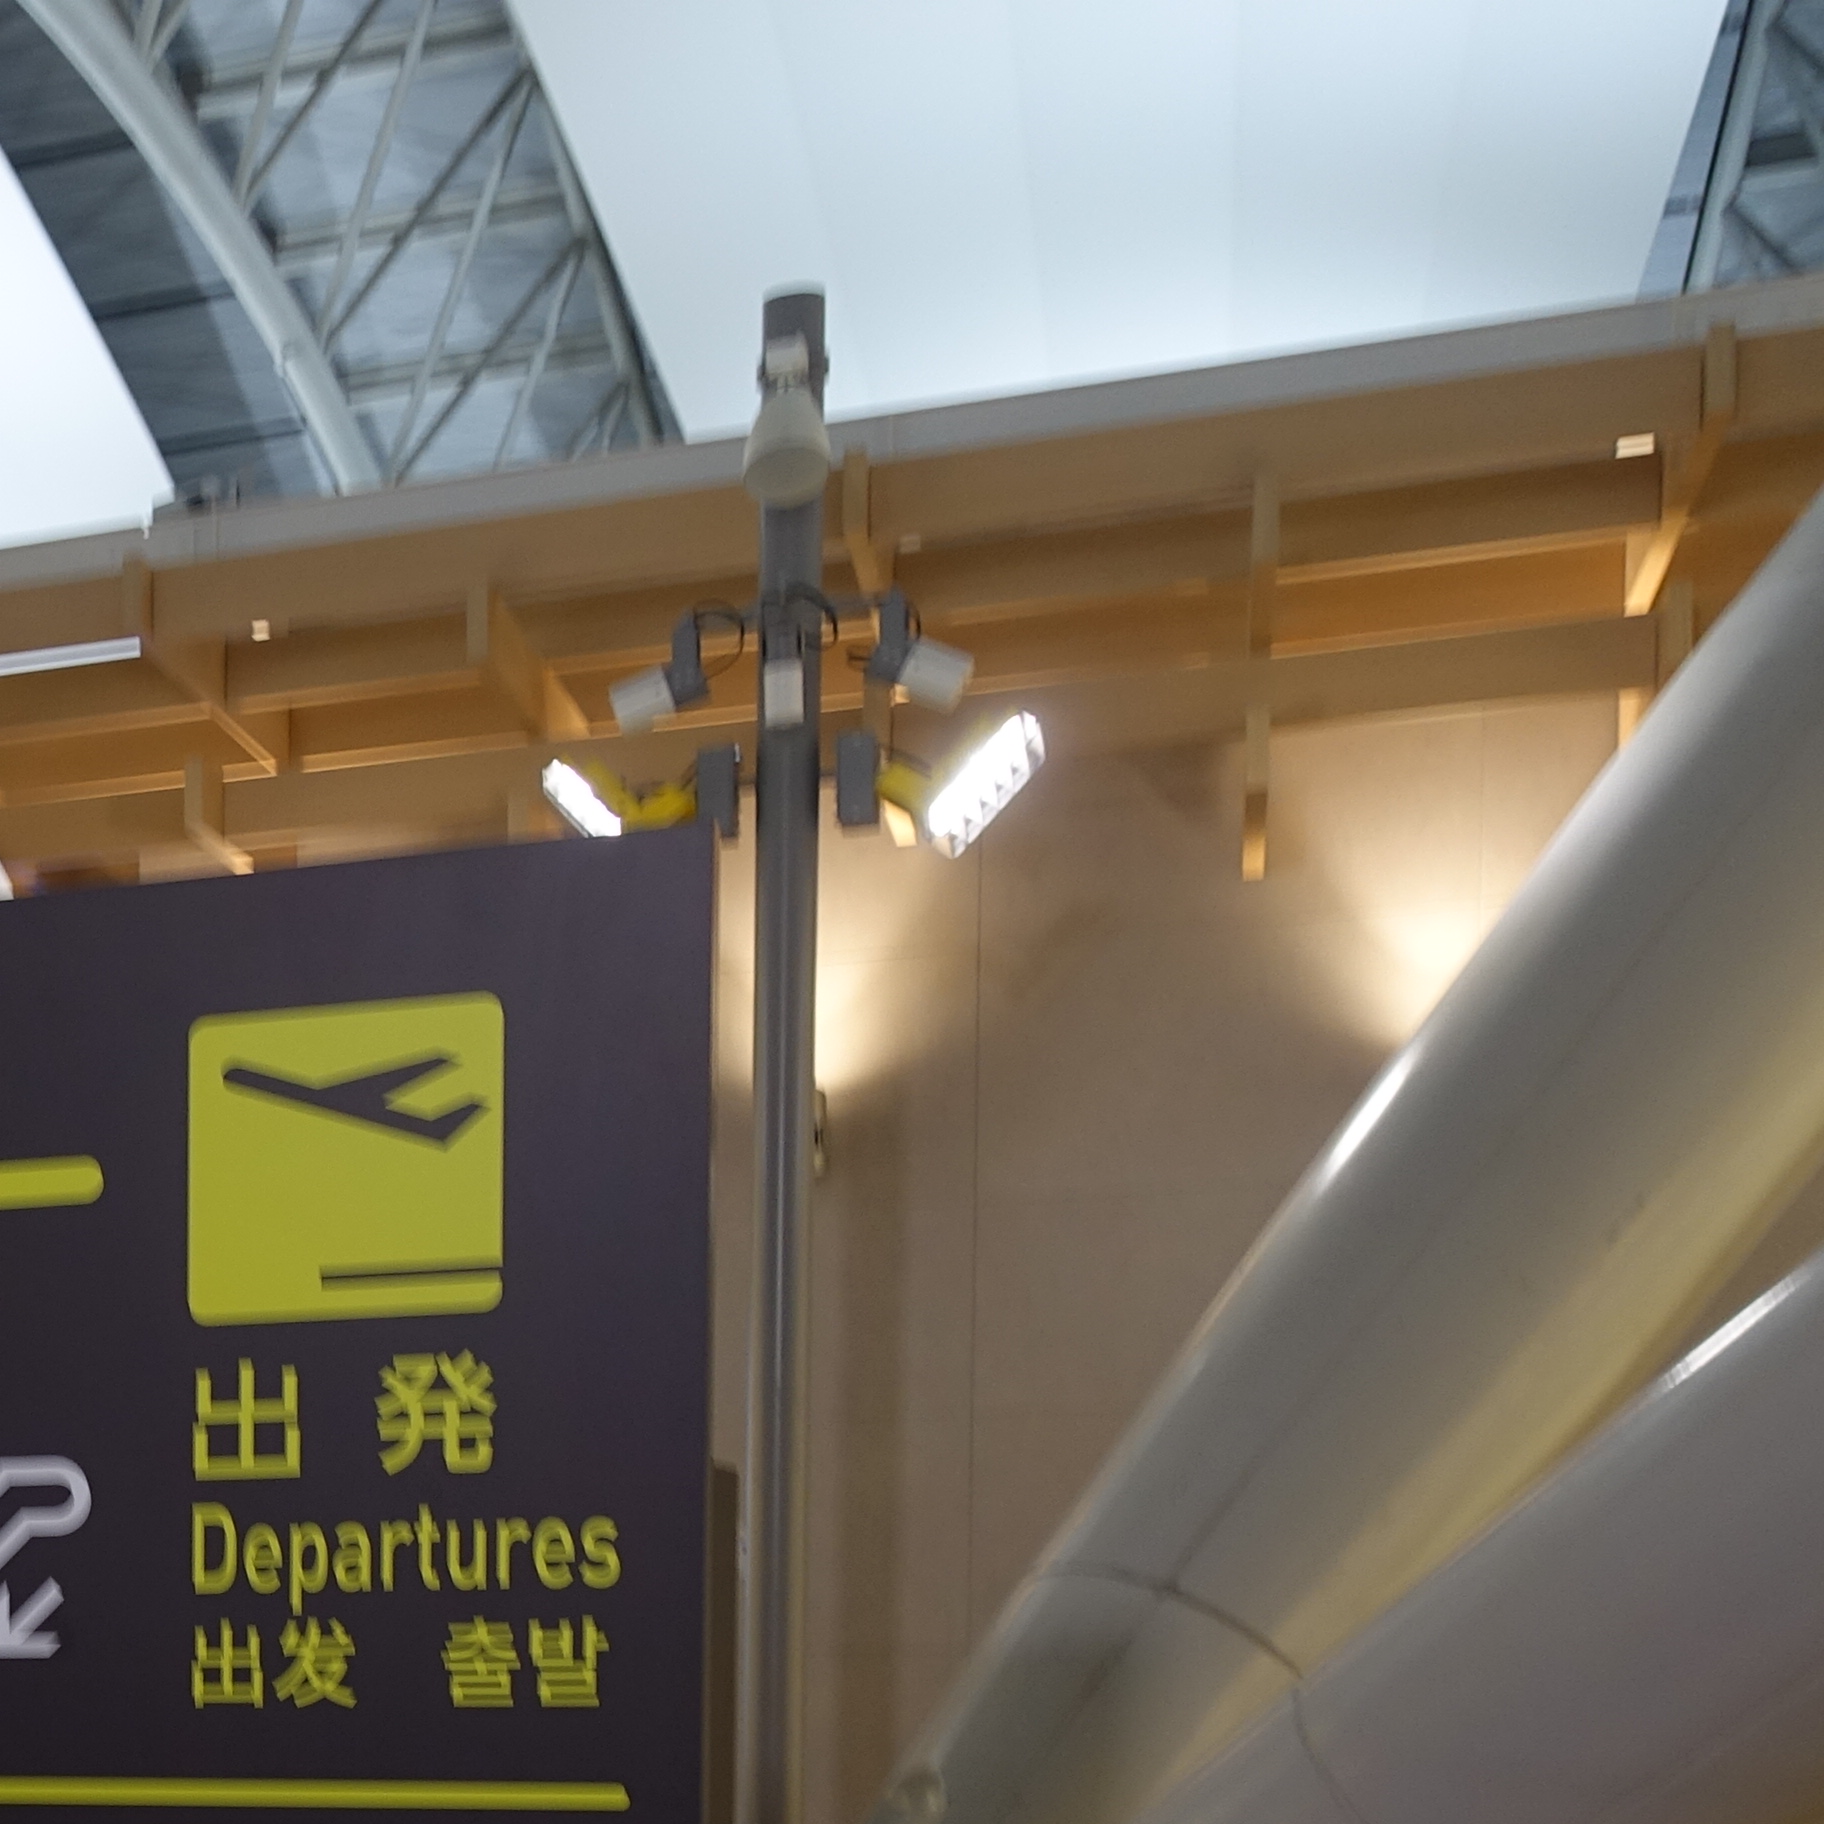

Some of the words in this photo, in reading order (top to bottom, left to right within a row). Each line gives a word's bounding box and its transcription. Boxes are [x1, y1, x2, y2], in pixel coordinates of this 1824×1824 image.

[192, 1350, 498, 1480] 出発
[192, 1502, 623, 1615] Departures
[191, 1616, 357, 1708] 出发
[441, 1615, 610, 1708] 출발
